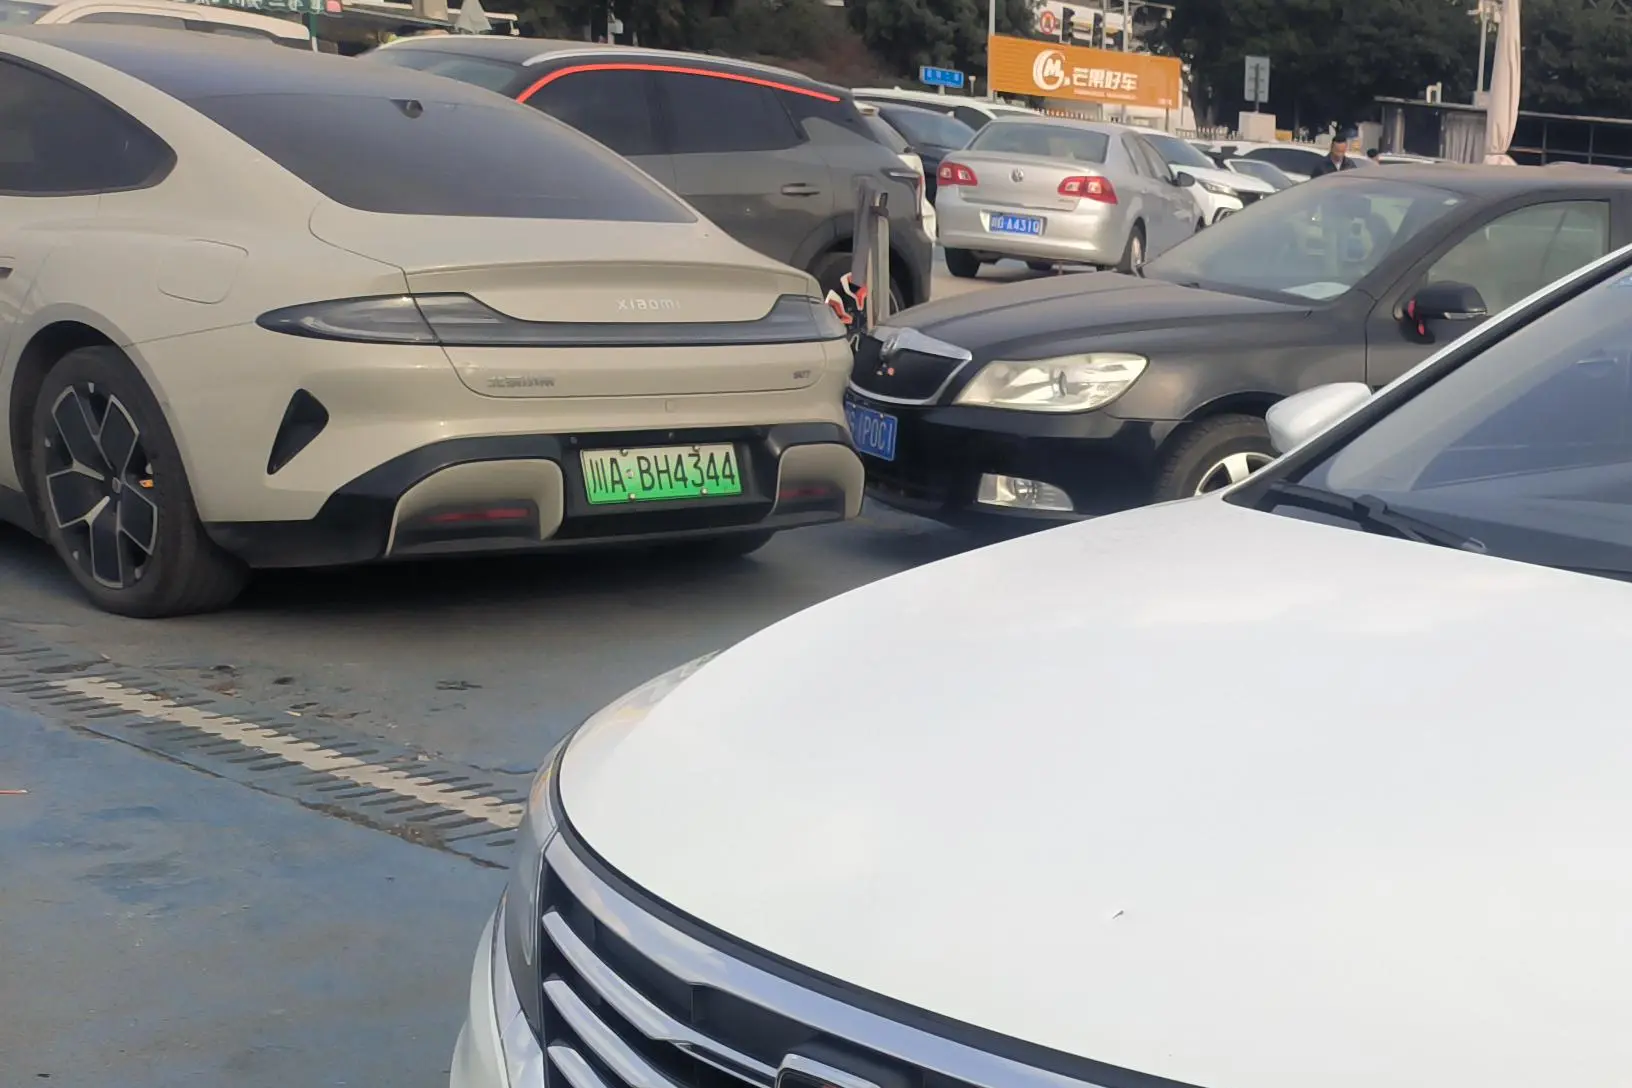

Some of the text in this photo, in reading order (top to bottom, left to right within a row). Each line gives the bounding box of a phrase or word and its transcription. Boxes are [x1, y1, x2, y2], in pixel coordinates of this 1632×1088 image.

[1072, 67, 1138, 91] 芒果好车
[617, 297, 681, 311] xiaomi
